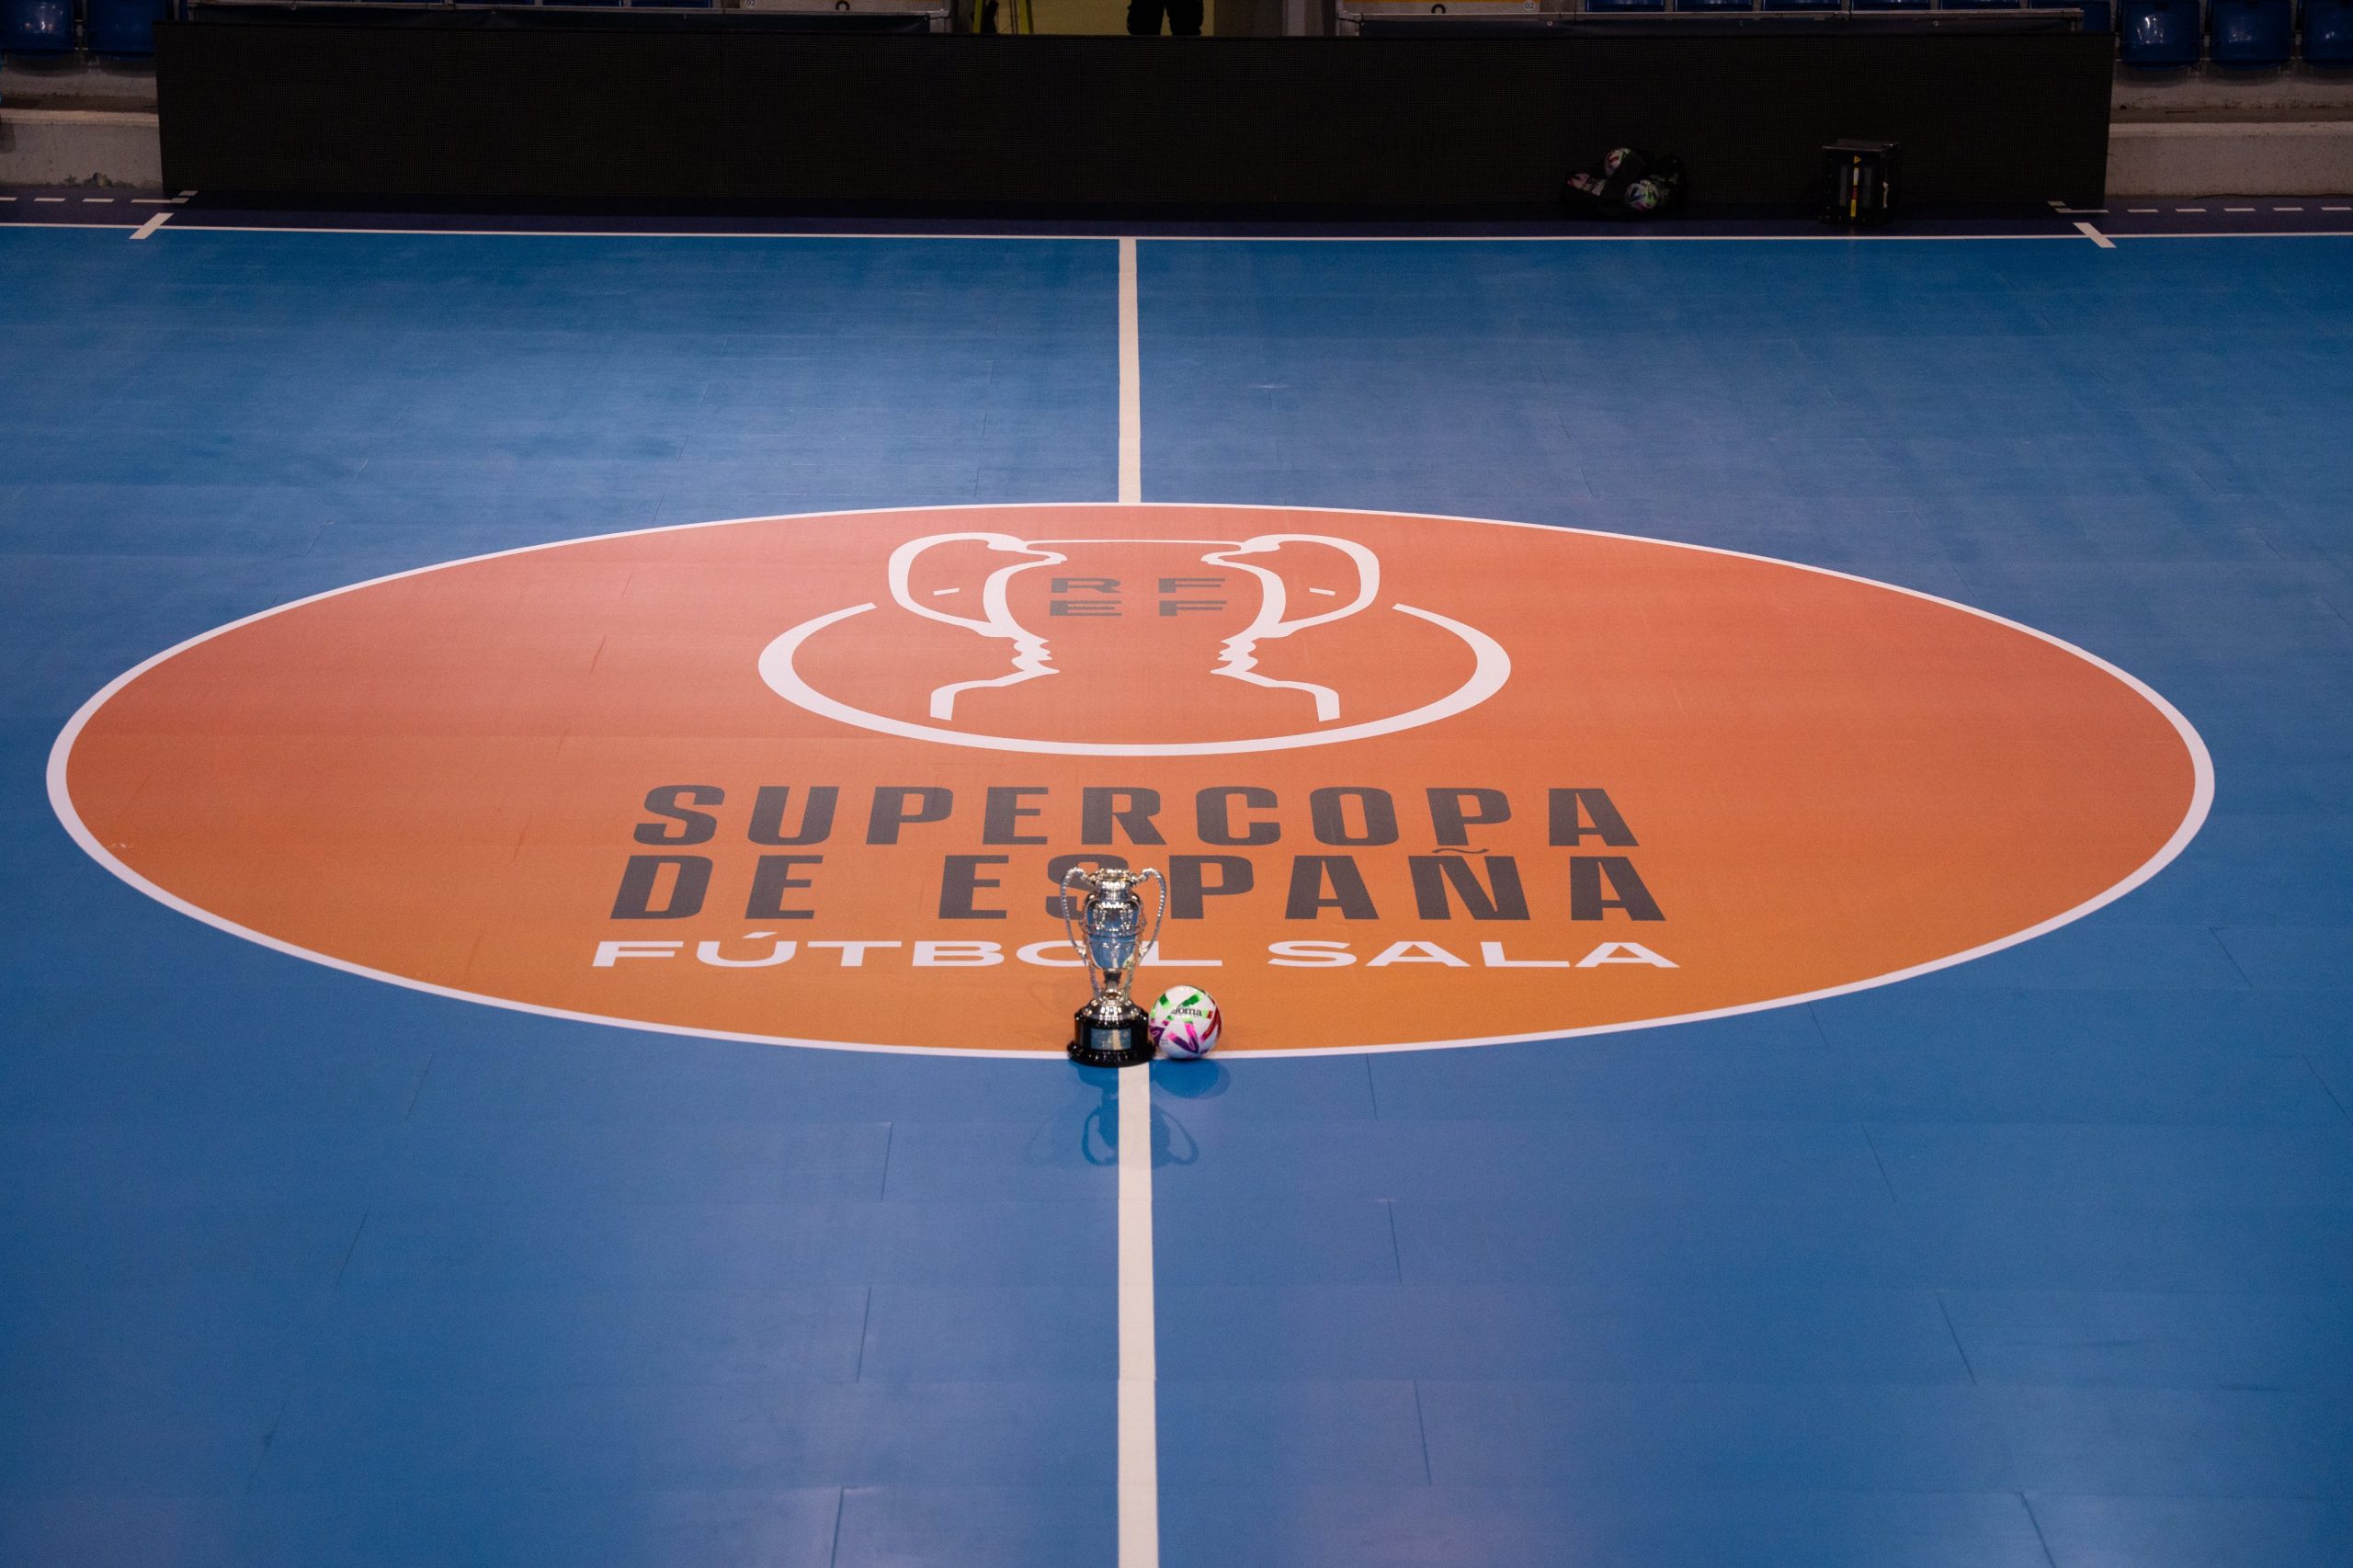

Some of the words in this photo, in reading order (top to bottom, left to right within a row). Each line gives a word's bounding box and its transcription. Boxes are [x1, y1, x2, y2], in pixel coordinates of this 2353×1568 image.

[633, 784, 1641, 846] SUPERCOPA
[608, 854, 824, 920] DE
[938, 847, 1667, 922] ESPAÑA
[592, 931, 1223, 968] FÚTBOL
[1267, 940, 1681, 969] SALA
